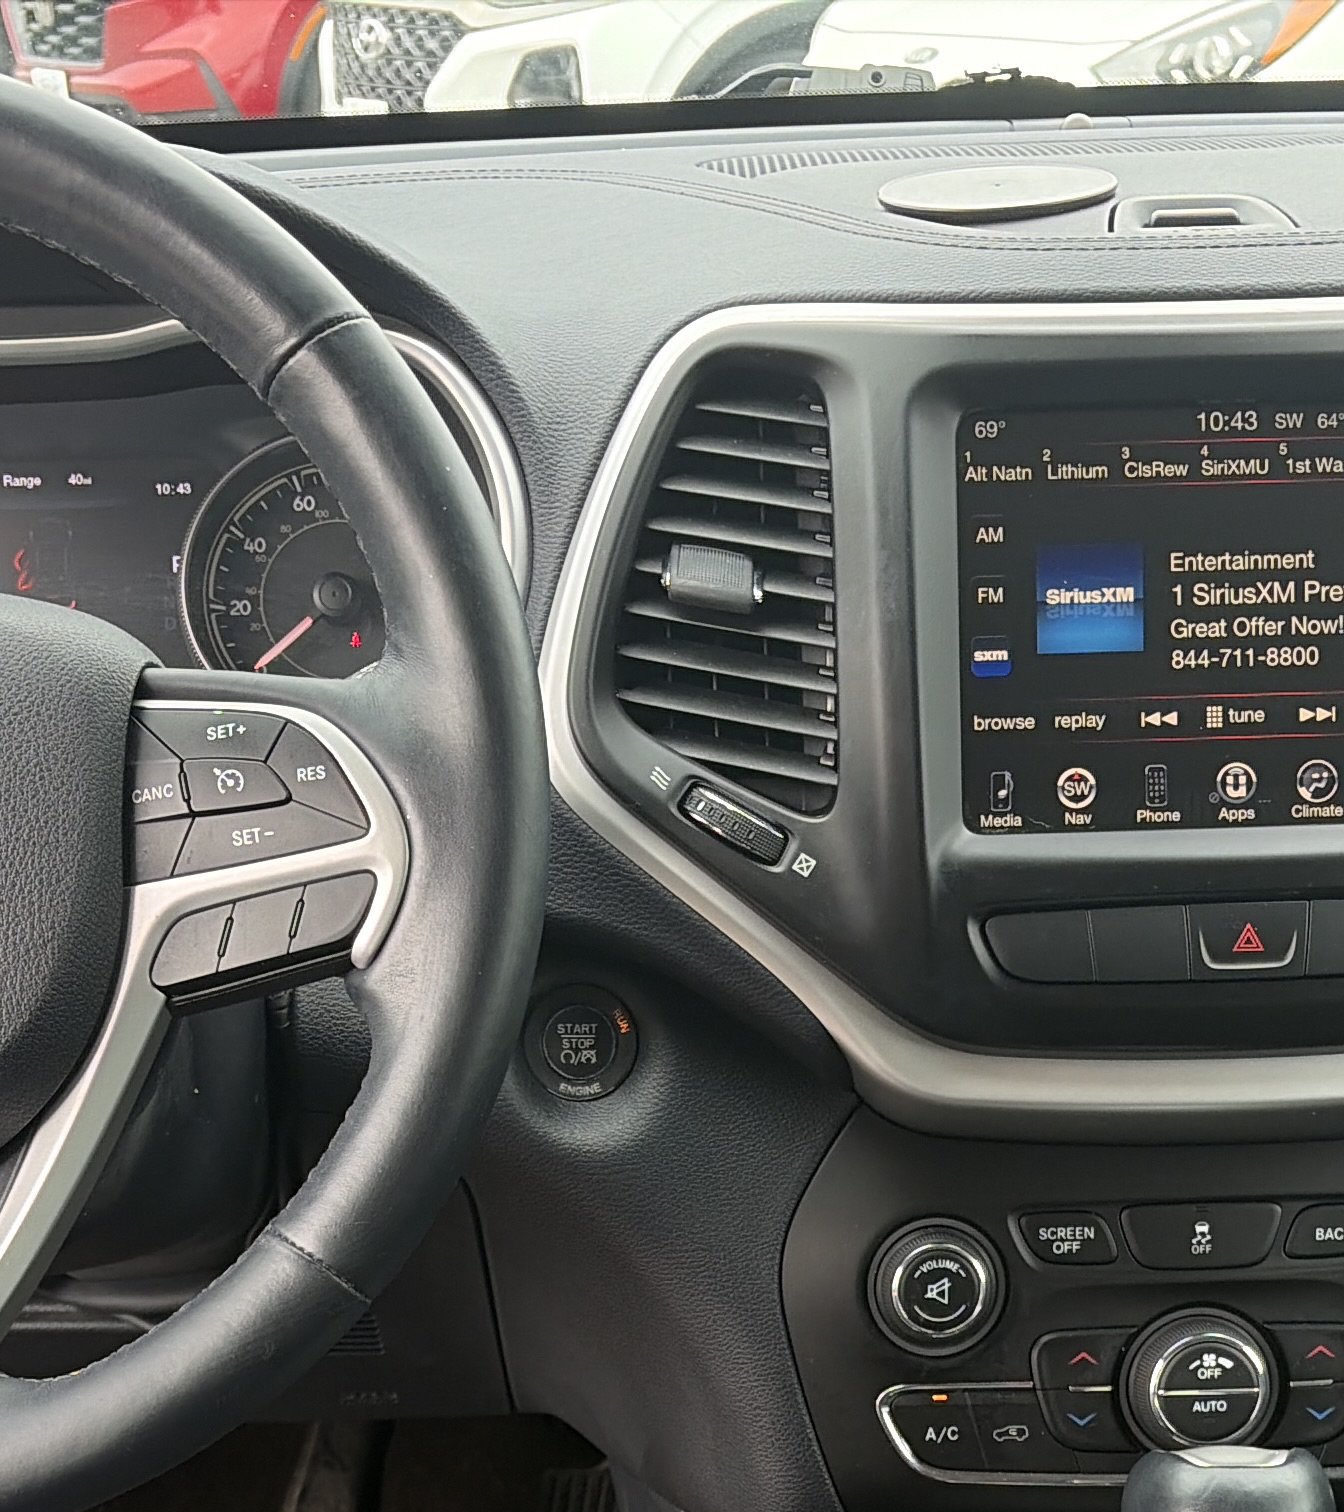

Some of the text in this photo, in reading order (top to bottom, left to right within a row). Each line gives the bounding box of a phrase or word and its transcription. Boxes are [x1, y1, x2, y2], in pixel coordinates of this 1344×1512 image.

[974, 420, 1006, 438] 69°
[1196, 411, 1258, 431] 10:43
[1275, 413, 1304, 429] SW
[964, 451, 972, 463] 1
[1042, 449, 1051, 461] 2
[1121, 447, 1130, 459] 3
[1200, 445, 1209, 457] 4
[1279, 443, 1288, 455] 5
[964, 465, 1033, 481] Alt Natn
[1047, 463, 1108, 480] Lithium
[1201, 458, 1269, 476] SiriXMU
[1286, 457, 1344, 474] 1st Wa
[3, 474, 42, 488] Range
[155, 483, 192, 495] 10:43
[292, 495, 316, 512] 60
[975, 527, 1004, 543] AM
[243, 537, 267, 554] 40
[1170, 550, 1315, 572] Entertainment
[977, 587, 1004, 603] FM
[1045, 586, 1135, 605] SiriusXM
[1171, 584, 1182, 606] 1
[1192, 580, 1296, 606] SiriusXM
[229, 599, 252, 616] 20
[1170, 614, 1344, 638] Great Offer Now!
[973, 649, 1009, 662] sxm
[1171, 646, 1320, 669] 844-711-8800
[973, 714, 1036, 731] browse
[1054, 712, 1106, 732] replay
[1228, 708, 1266, 723] tune
[296, 765, 326, 782] RES
[131, 783, 174, 804] CANC
[1063, 780, 1091, 796] SW
[1064, 812, 1093, 826] Nav
[1136, 809, 1182, 823] Phone
[1218, 807, 1256, 823] Apps
[1291, 804, 1344, 818] Climate
[980, 813, 1023, 828] Media
[556, 1023, 598, 1035] START
[613, 1008, 631, 1036] RUN
[561, 1038, 595, 1050] STOP
[558, 1082, 603, 1096] ENGINE
[1038, 1225, 1095, 1241] SCREEN
[1052, 1240, 1082, 1255] OFF
[1190, 1244, 1212, 1255] OFF
[919, 1259, 961, 1273] VOLUME
[1196, 1367, 1222, 1380] OFF
[1192, 1400, 1227, 1413] AUTO
[924, 1425, 960, 1444] A/C
